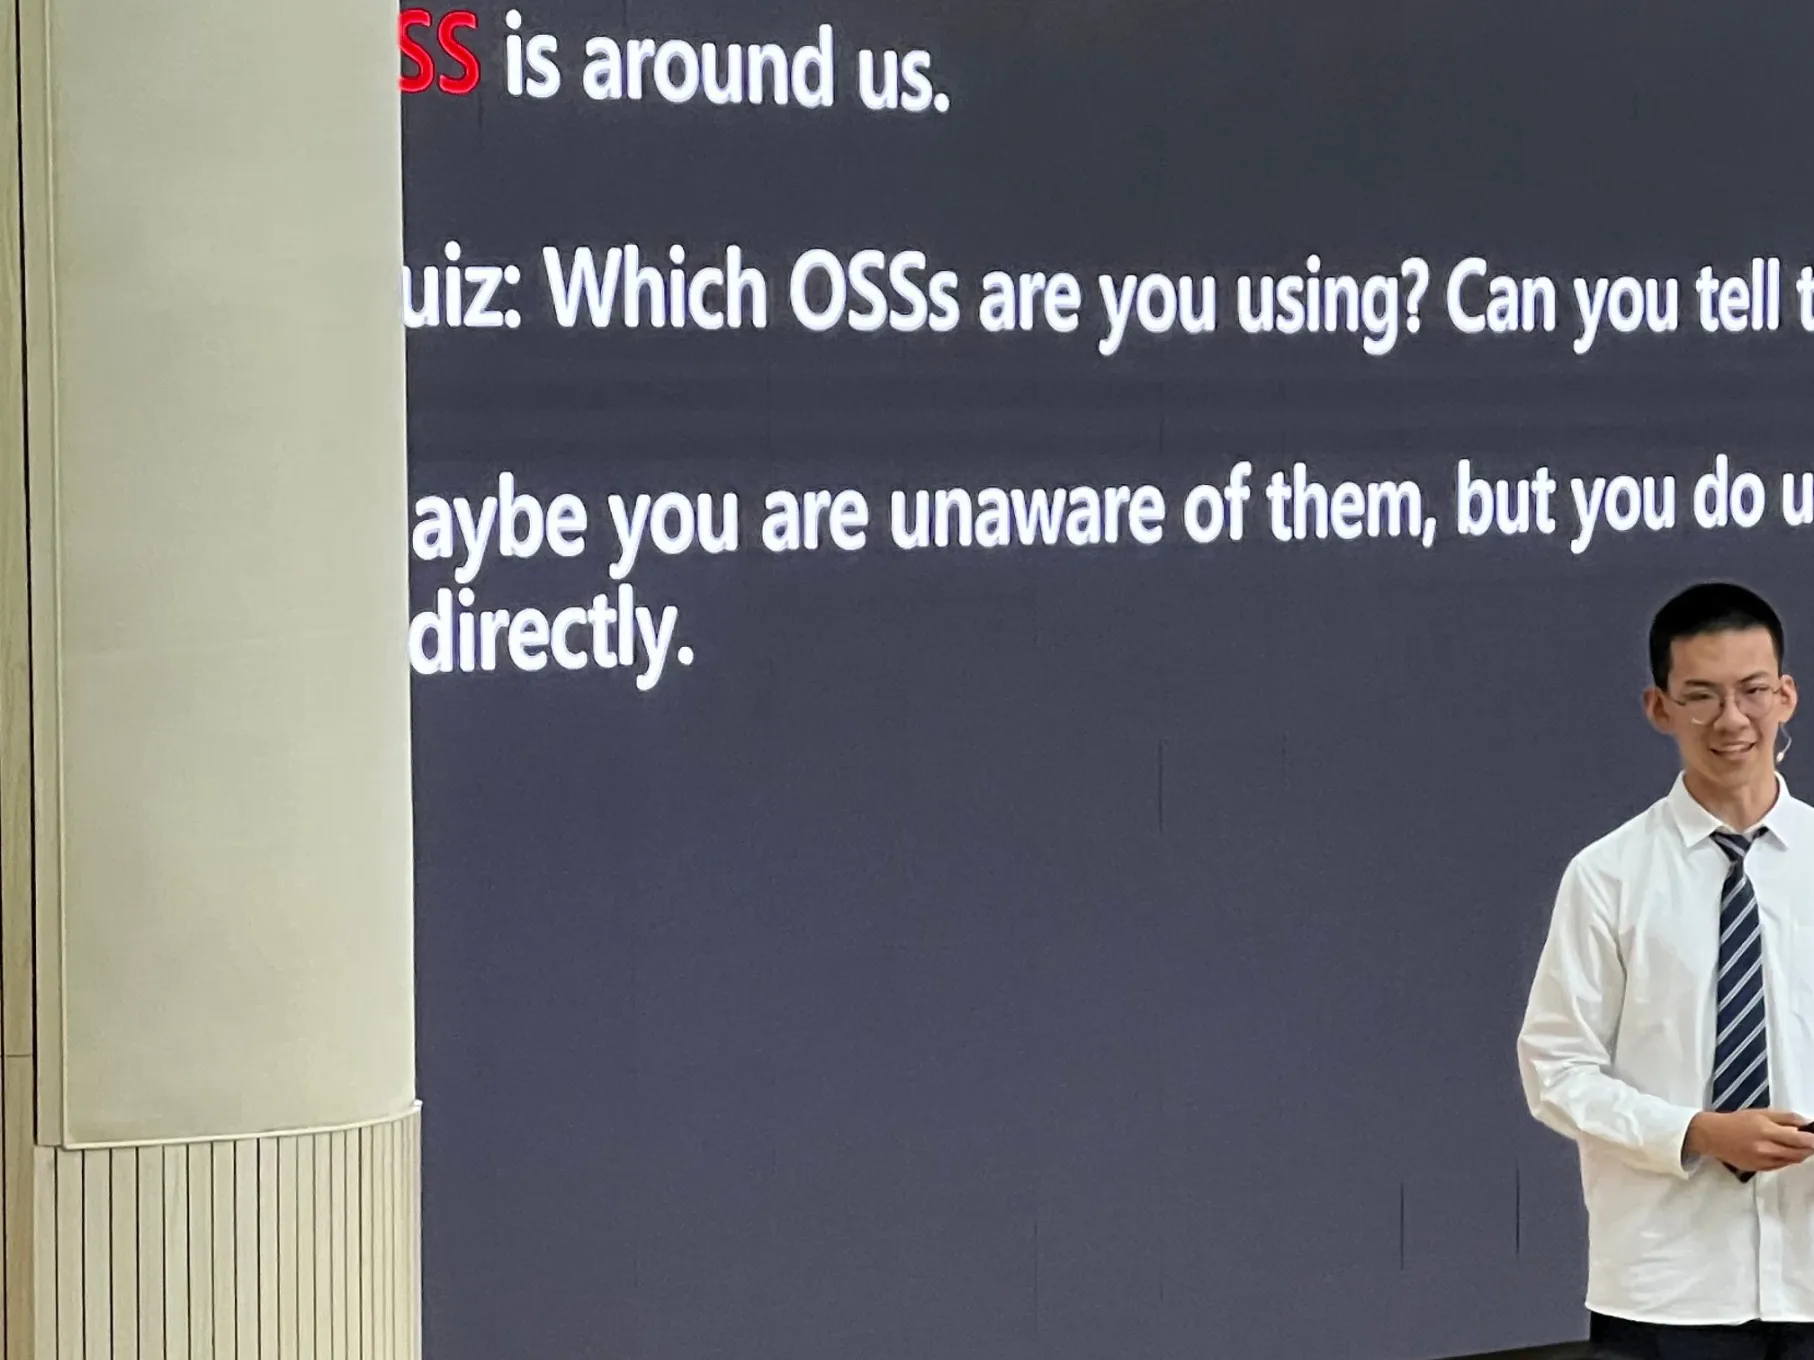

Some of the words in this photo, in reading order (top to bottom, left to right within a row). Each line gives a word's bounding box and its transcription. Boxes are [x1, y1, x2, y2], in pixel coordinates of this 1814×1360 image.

[398, 7, 481, 95] SS
[505, 8, 561, 99] is
[582, 23, 834, 109] around
[858, 49, 950, 113] us.
[402, 240, 522, 329] uiz:
[542, 243, 767, 330] Which
[789, 248, 960, 332] OSSs
[979, 271, 1082, 333] are
[1098, 274, 1216, 357] you
[1237, 254, 1430, 357] using?
[1446, 257, 1556, 334] Can
[1573, 276, 1678, 355] you
[1695, 257, 1780, 333] tell
[412, 471, 588, 585] aybe
[607, 491, 739, 581] you
[761, 489, 869, 553] are
[890, 484, 1166, 550] unaware
[1183, 460, 1252, 544] of
[1265, 462, 1437, 549] them,
[1457, 458, 1557, 537] but
[1570, 475, 1676, 555] you
[1693, 453, 1766, 529] do
[408, 582, 695, 692] directly.
